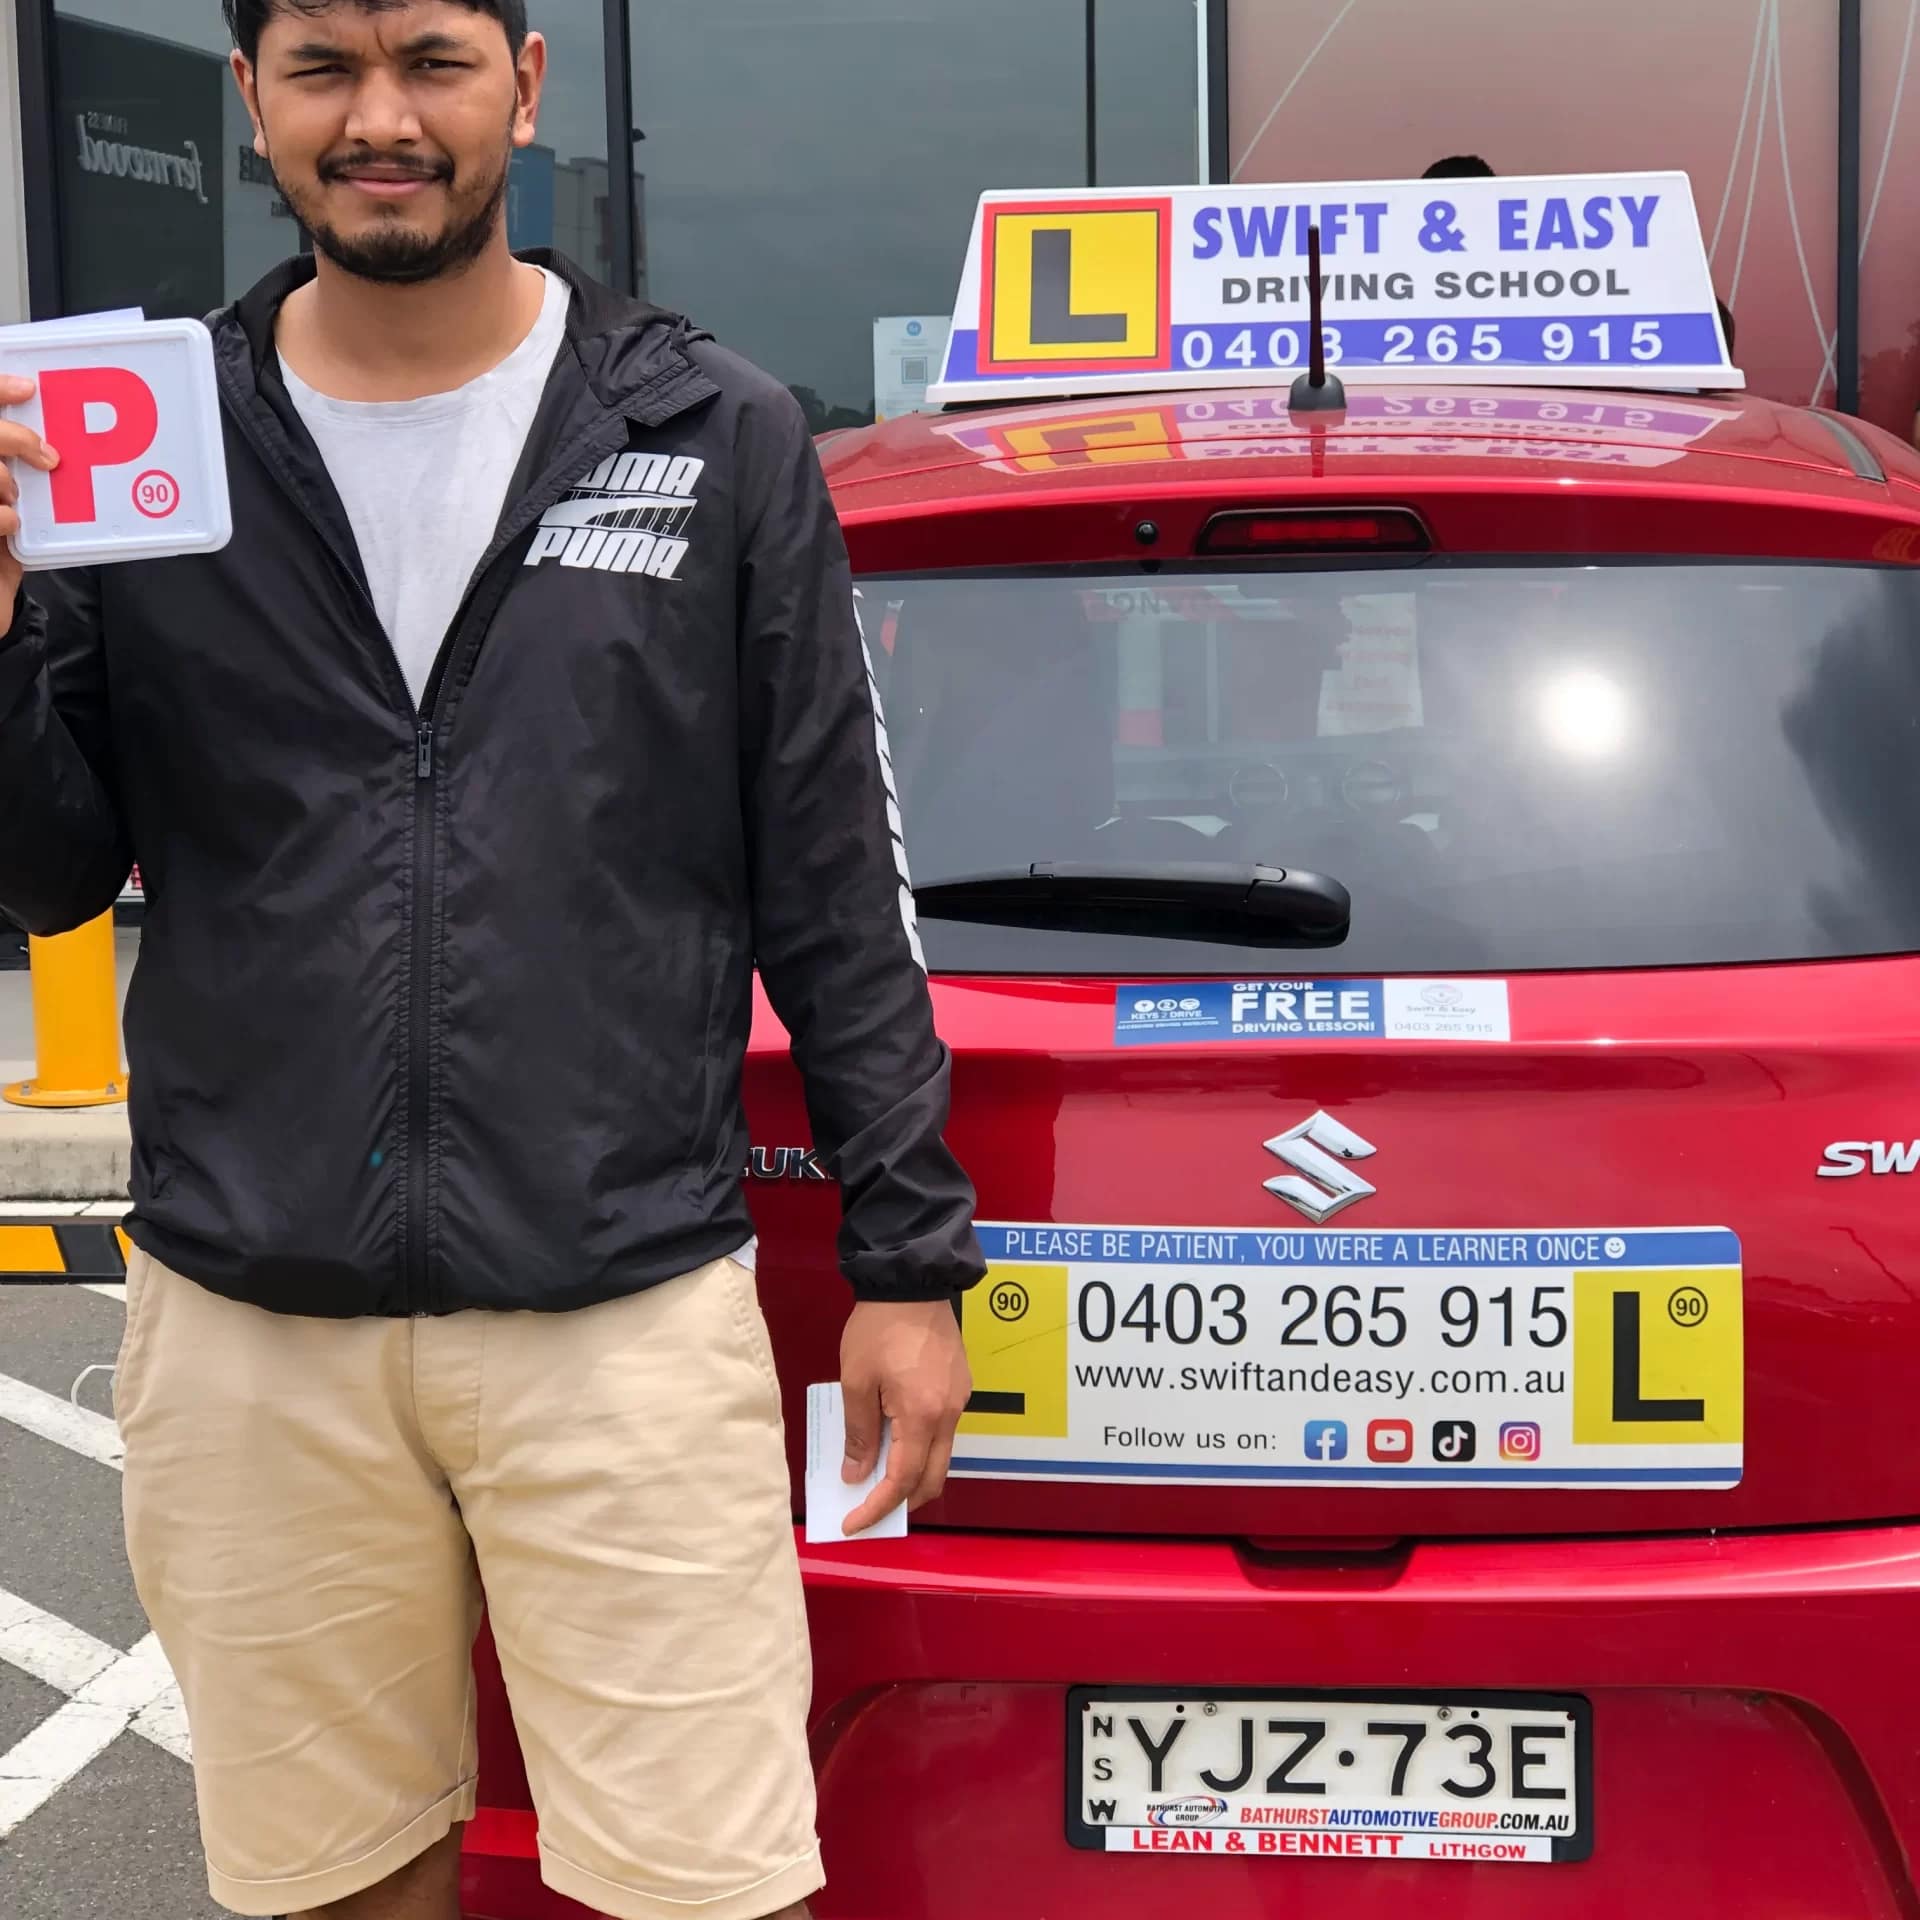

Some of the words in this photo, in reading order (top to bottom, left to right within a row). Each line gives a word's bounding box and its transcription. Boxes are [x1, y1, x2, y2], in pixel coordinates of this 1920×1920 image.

[1192, 203, 1388, 259] SWIFT
[1418, 200, 1467, 253] &
[1498, 195, 1662, 250] EASY
[1030, 229, 1127, 344] L
[1433, 267, 1631, 301] SCHOOL
[1382, 323, 1504, 365] 265
[1541, 321, 1665, 362] 915
[38, 367, 158, 524] P
[574, 452, 705, 497] UMA
[142, 484, 169, 504] 90
[523, 527, 690, 581] PUMA
[1233, 983, 1264, 992] GET
[1268, 982, 1314, 991] YOUR
[1231, 991, 1371, 1022] FREE
[1232, 1022, 1303, 1034] DRIVING
[1006, 1230, 1093, 1257] PLEASE
[1103, 1234, 1131, 1257] BE
[1141, 1234, 1245, 1262] PATIENT,
[1256, 1236, 1304, 1261] YOU
[1315, 1236, 1383, 1261] WERE
[1393, 1237, 1409, 1261] A
[1418, 1236, 1528, 1261] LEARNER
[1537, 1235, 1600, 1261] ONCE
[997, 1293, 1022, 1312] 90
[1077, 1280, 1248, 1346] 0403
[1280, 1284, 1407, 1348] 265
[1440, 1285, 1568, 1348] 915
[1675, 1298, 1701, 1317] 90
[1612, 1291, 1705, 1422] L
[1075, 1361, 1566, 1399] www.swiftandeasy.com.au
[1103, 1426, 1184, 1448] Follow
[1197, 1432, 1225, 1449] us
[1237, 1432, 1276, 1450] on:
[1240, 1807, 1570, 1832] BATHURSTAUTOMOTIVEGROUP.COM.AU
[1133, 1829, 1213, 1851] LEAN
[1225, 1831, 1246, 1852] &
[1257, 1832, 1405, 1856] BENNETT
[1429, 1842, 1527, 1859] LITHGOW
